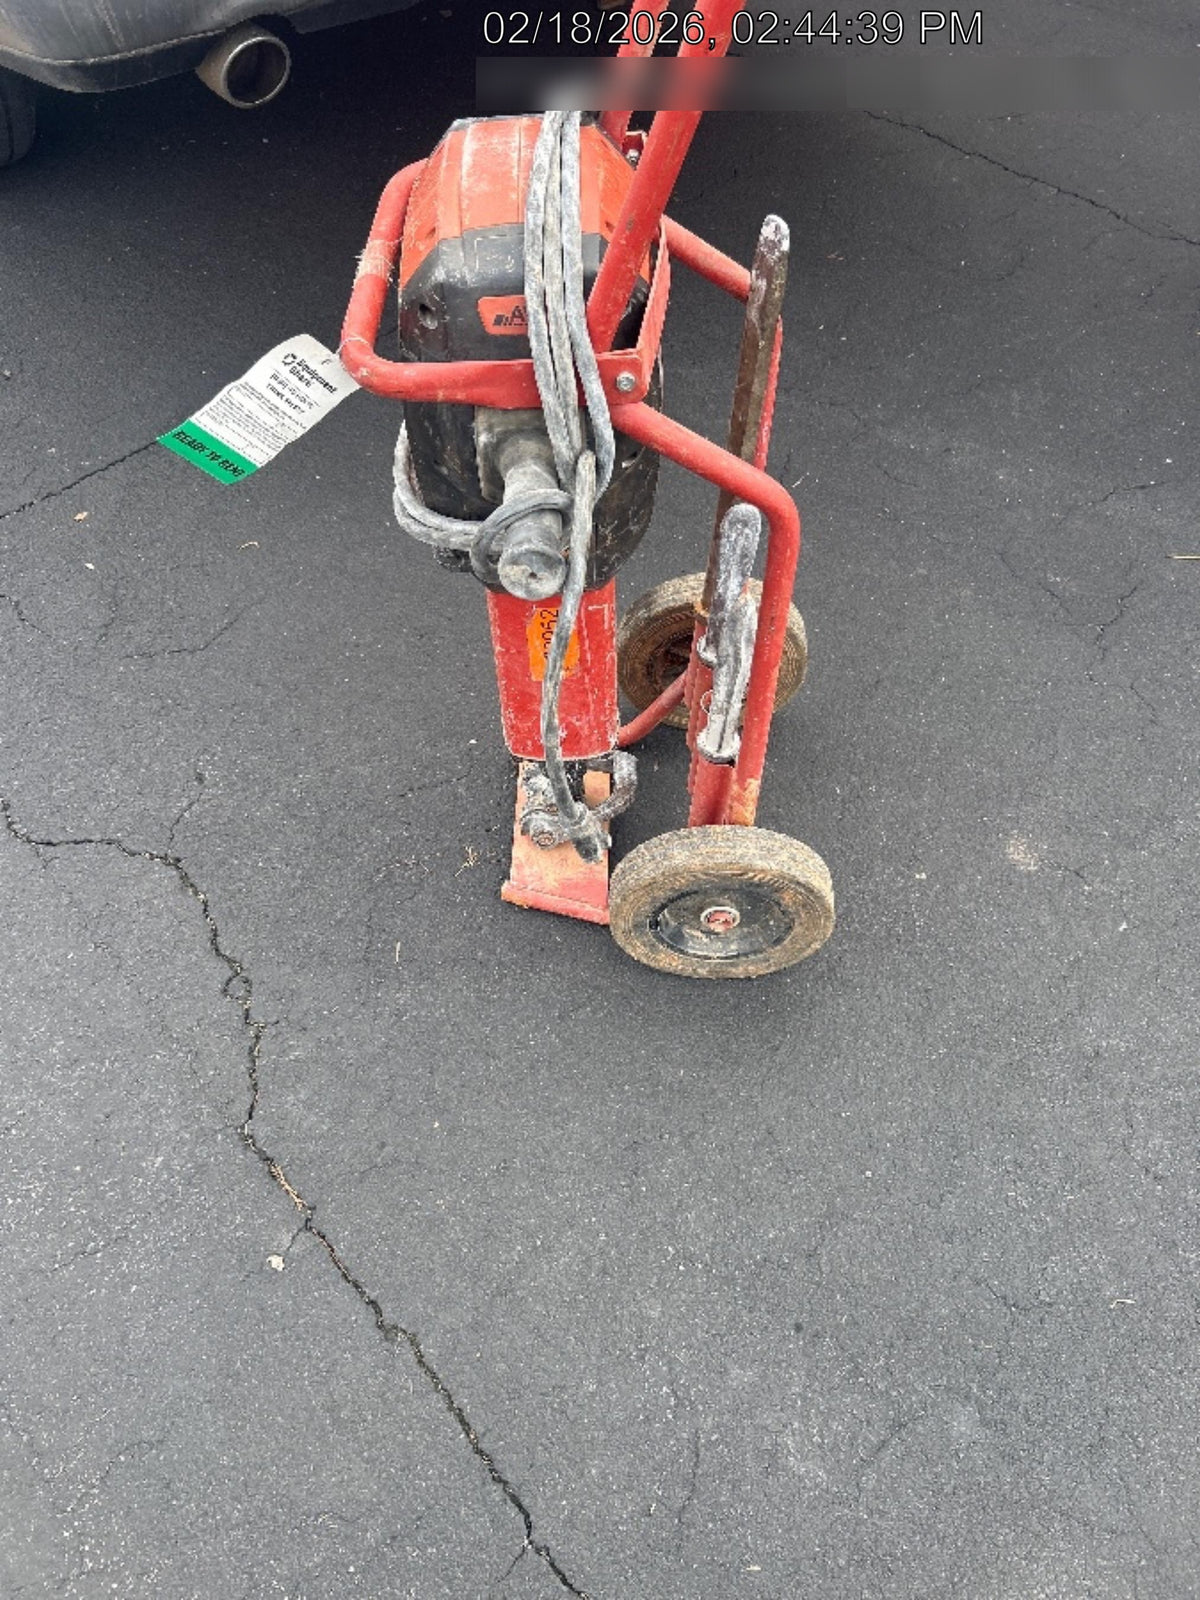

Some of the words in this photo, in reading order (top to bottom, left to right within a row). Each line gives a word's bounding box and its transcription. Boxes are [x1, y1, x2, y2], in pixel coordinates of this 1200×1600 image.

[289, 366, 312, 388] Share
[296, 359, 338, 394] Equipment
[173, 430, 210, 454] READY
[205, 450, 222, 461] TO
[218, 458, 246, 477] RENT
